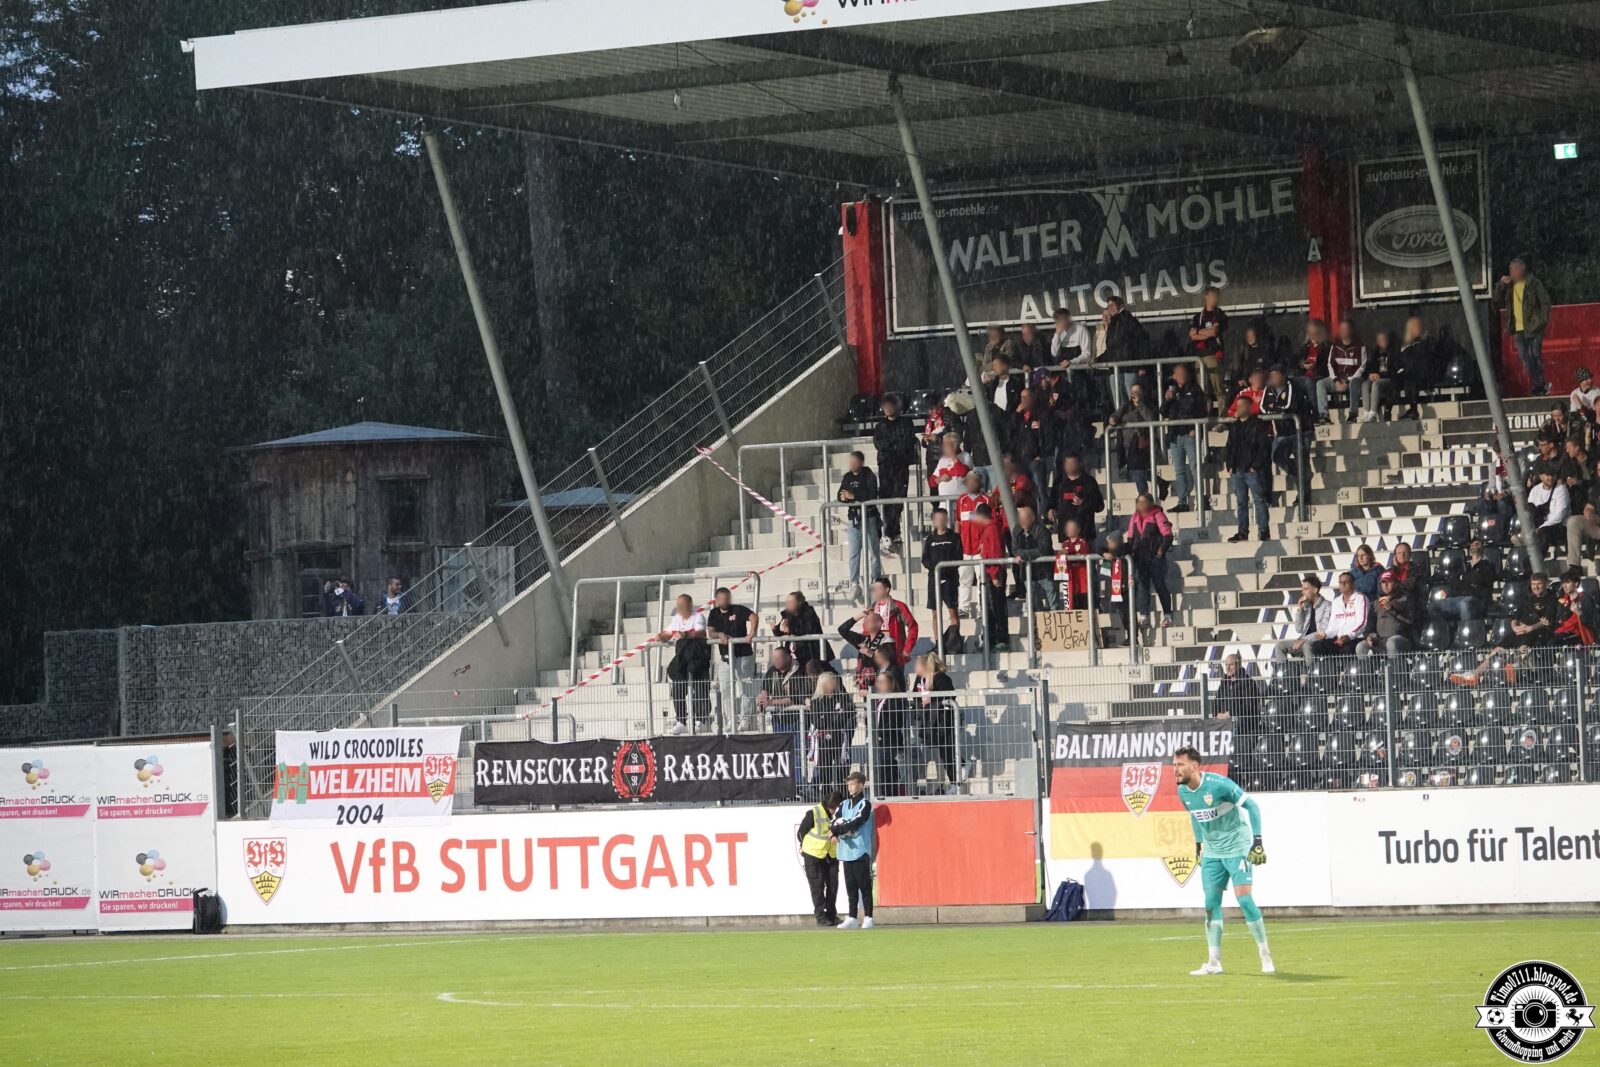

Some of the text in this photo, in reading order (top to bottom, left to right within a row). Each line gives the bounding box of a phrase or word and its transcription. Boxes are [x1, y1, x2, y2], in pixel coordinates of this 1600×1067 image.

[1365, 163, 1473, 182] autohaus-mhle.de
[901, 202, 999, 221] autous-moehle.de
[1146, 177, 1294, 238] MÖHLE
[949, 219, 1082, 272] WALTER
[1307, 237, 1322, 262] A
[1019, 259, 1228, 322] AUTOHAUS
[1043, 611, 1083, 626] BITTE
[309, 738, 424, 760] WILD CROCODILES
[1055, 730, 1234, 759] BALTMANNSWEILER
[475, 756, 609, 787] REMSECKER
[663, 751, 790, 783] RABAUKEN
[309, 767, 421, 795] WELZHEIM
[99, 808, 109, 816] Sie
[145, 807, 174, 815] drucken!
[336, 803, 384, 825] 2004
[1378, 826, 1600, 864] Turbo für Talent
[330, 833, 749, 894] VfB STUTTGART
[35, 899, 61, 907] drucken!
[101, 901, 178, 912] Sie sparen, wir drucken!
